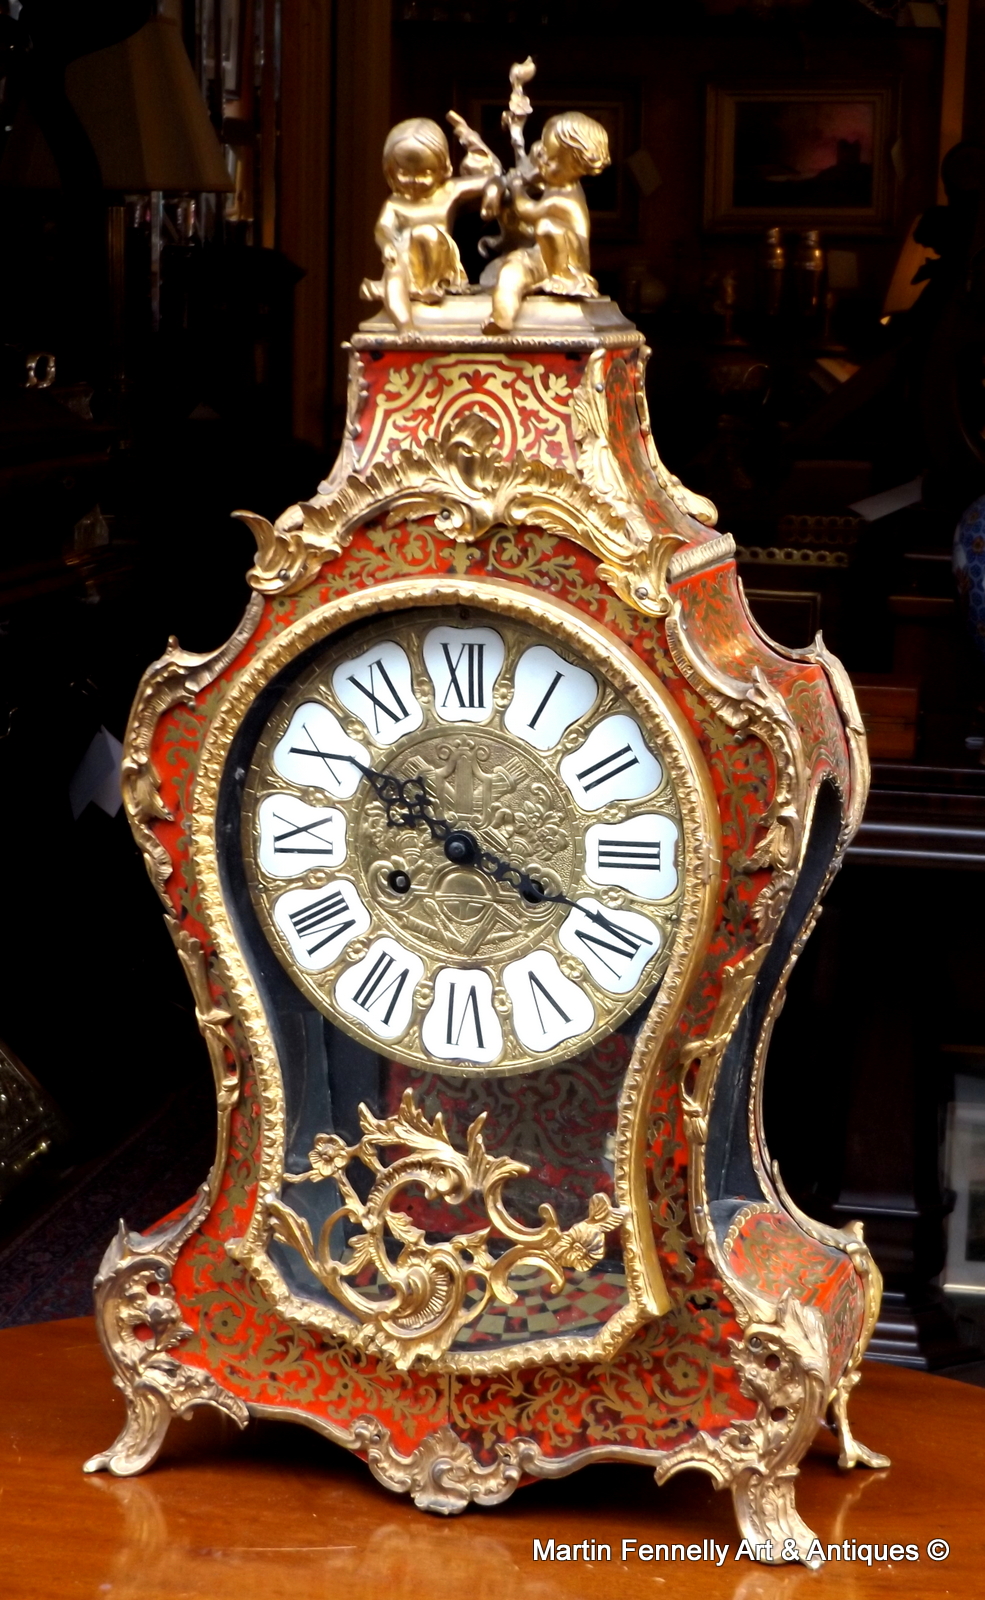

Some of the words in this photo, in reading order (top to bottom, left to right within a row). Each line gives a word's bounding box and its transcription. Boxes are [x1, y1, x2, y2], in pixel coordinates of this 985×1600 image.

[346, 658, 412, 736] XI
[440, 642, 486, 710] XII
[527, 670, 566, 731] I
[288, 723, 356, 786] X
[576, 742, 640, 793] II
[273, 812, 333, 855] IX
[598, 839, 661, 872] III
[289, 890, 356, 957] VIII
[351, 950, 410, 1027] VII
[446, 982, 486, 1049] VI
[528, 970, 572, 1035] V
